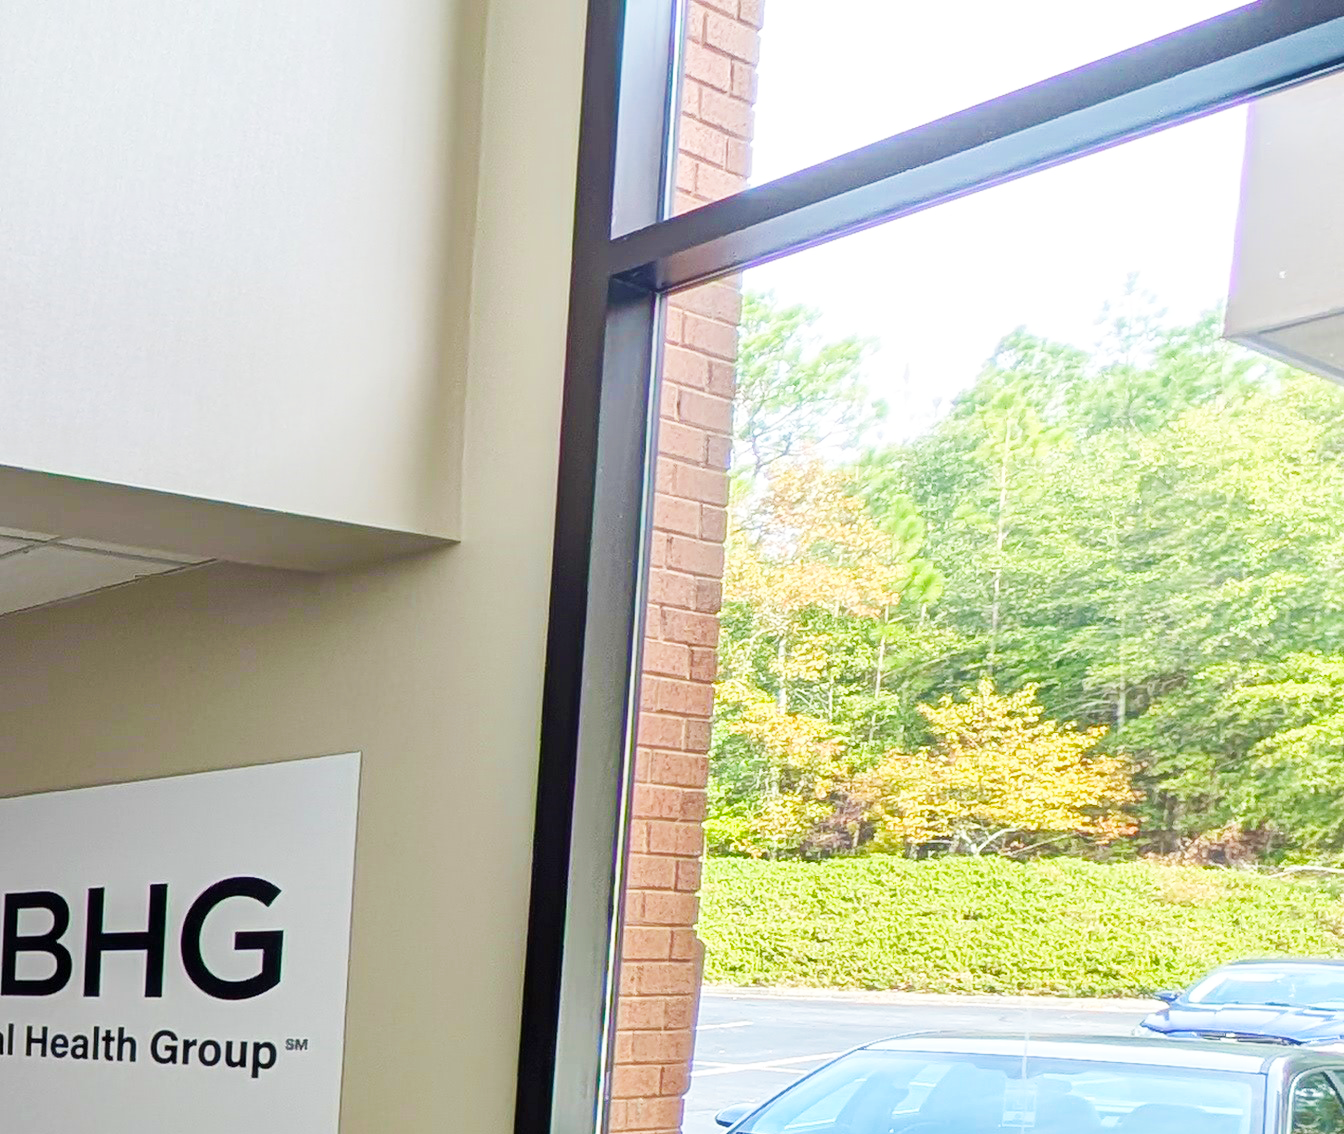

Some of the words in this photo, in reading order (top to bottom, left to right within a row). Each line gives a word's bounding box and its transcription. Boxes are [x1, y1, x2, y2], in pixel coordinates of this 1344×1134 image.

[0, 876, 284, 1000] BHG
[25, 1025, 137, 1062] Health
[150, 1029, 278, 1078] Group
